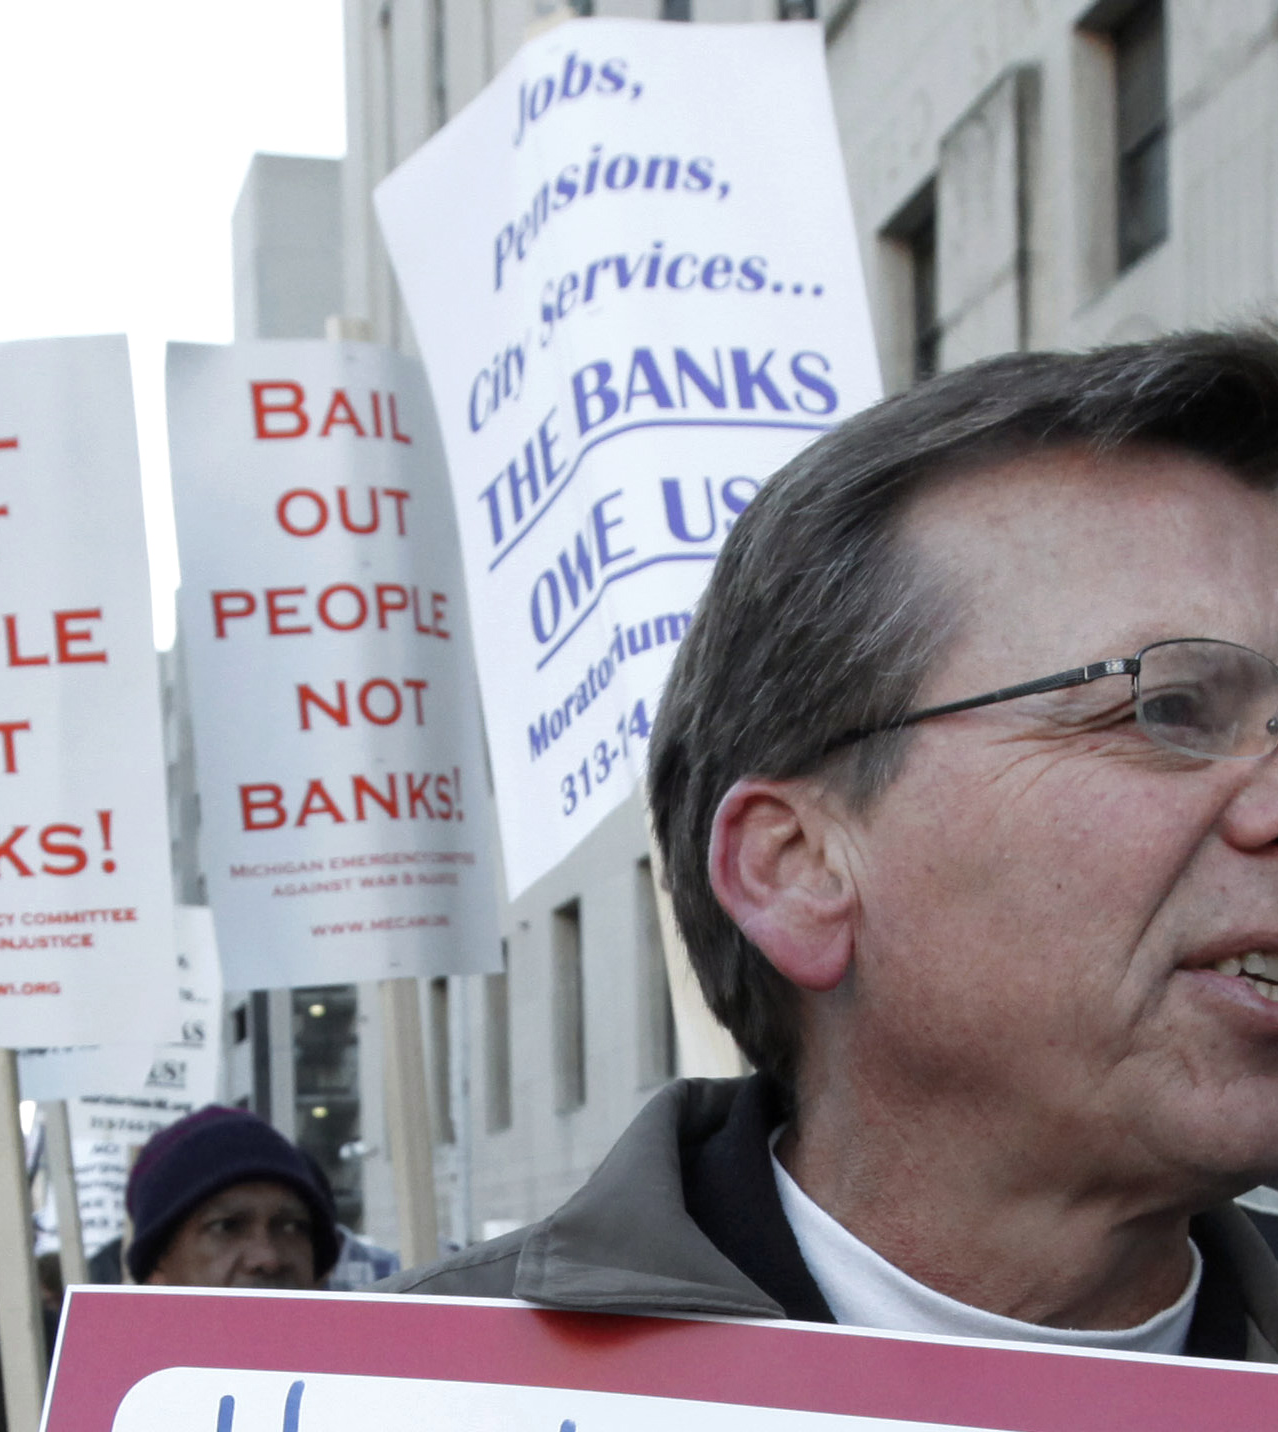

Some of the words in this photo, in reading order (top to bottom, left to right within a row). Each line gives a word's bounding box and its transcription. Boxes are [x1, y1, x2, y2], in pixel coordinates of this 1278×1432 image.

[513, 49, 643, 146] Jobs,
[494, 144, 730, 292] Pensions,
[249, 380, 412, 444] BAIL
[468, 328, 532, 433] City
[477, 406, 567, 546] THE
[571, 347, 839, 437] BANKS
[276, 487, 411, 537] OUT
[531, 488, 635, 645] OWE
[210, 583, 450, 640] PEOPLE
[297, 678, 427, 732] NOT
[238, 769, 464, 832] BANKS!
